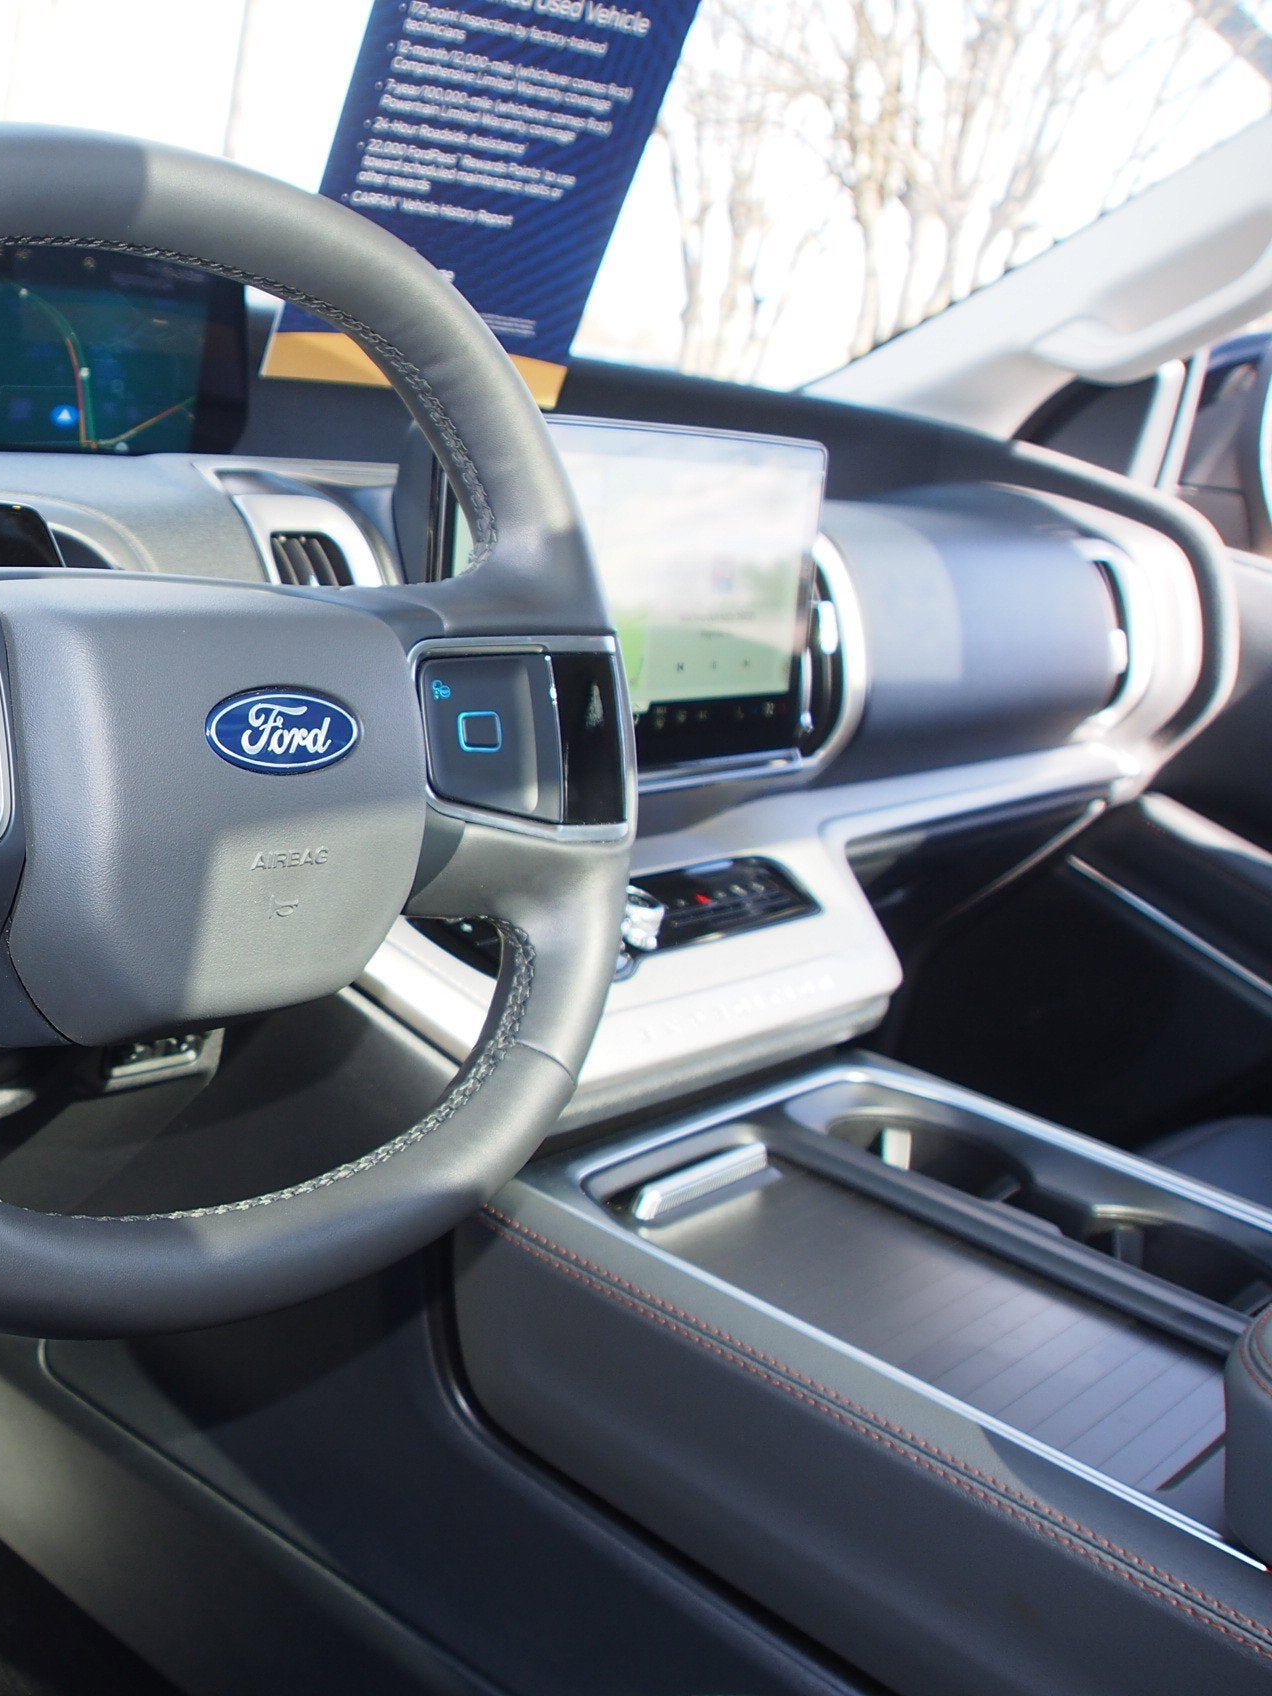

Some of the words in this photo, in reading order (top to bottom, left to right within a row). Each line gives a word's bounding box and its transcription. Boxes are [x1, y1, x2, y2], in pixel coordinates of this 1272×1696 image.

[403, 17, 468, 41] technicians
[457, 11, 516, 36] inspection
[526, 26, 609, 55] factory-trained
[585, 1, 651, 37] Vehicle
[390, 55, 475, 84] Comprehensive
[473, 72, 516, 92] Limited
[512, 79, 565, 101] Warranty
[563, 89, 614, 111] coverage
[569, 74, 610, 94] comes
[372, 116, 420, 136] 24-Hour
[417, 123, 470, 144] Roadside
[378, 93, 441, 117] Powertrain
[438, 104, 482, 124] Limited
[478, 111, 530, 133] Warranty
[527, 120, 580, 141] coverage
[548, 109, 590, 128] comes
[360, 153, 402, 172] toward
[400, 160, 458, 180] scheduled
[454, 168, 526, 191] maintenance
[522, 179, 554, 195] visits
[459, 153, 511, 173] Rewards
[355, 168, 388, 185] other
[385, 173, 433, 192] rewards
[399, 197, 441, 215] Vehicle
[437, 202, 479, 220] History
[475, 208, 517, 225] Report
[241, 702, 332, 755] Ford
[251, 847, 329, 871] AIRBAG
